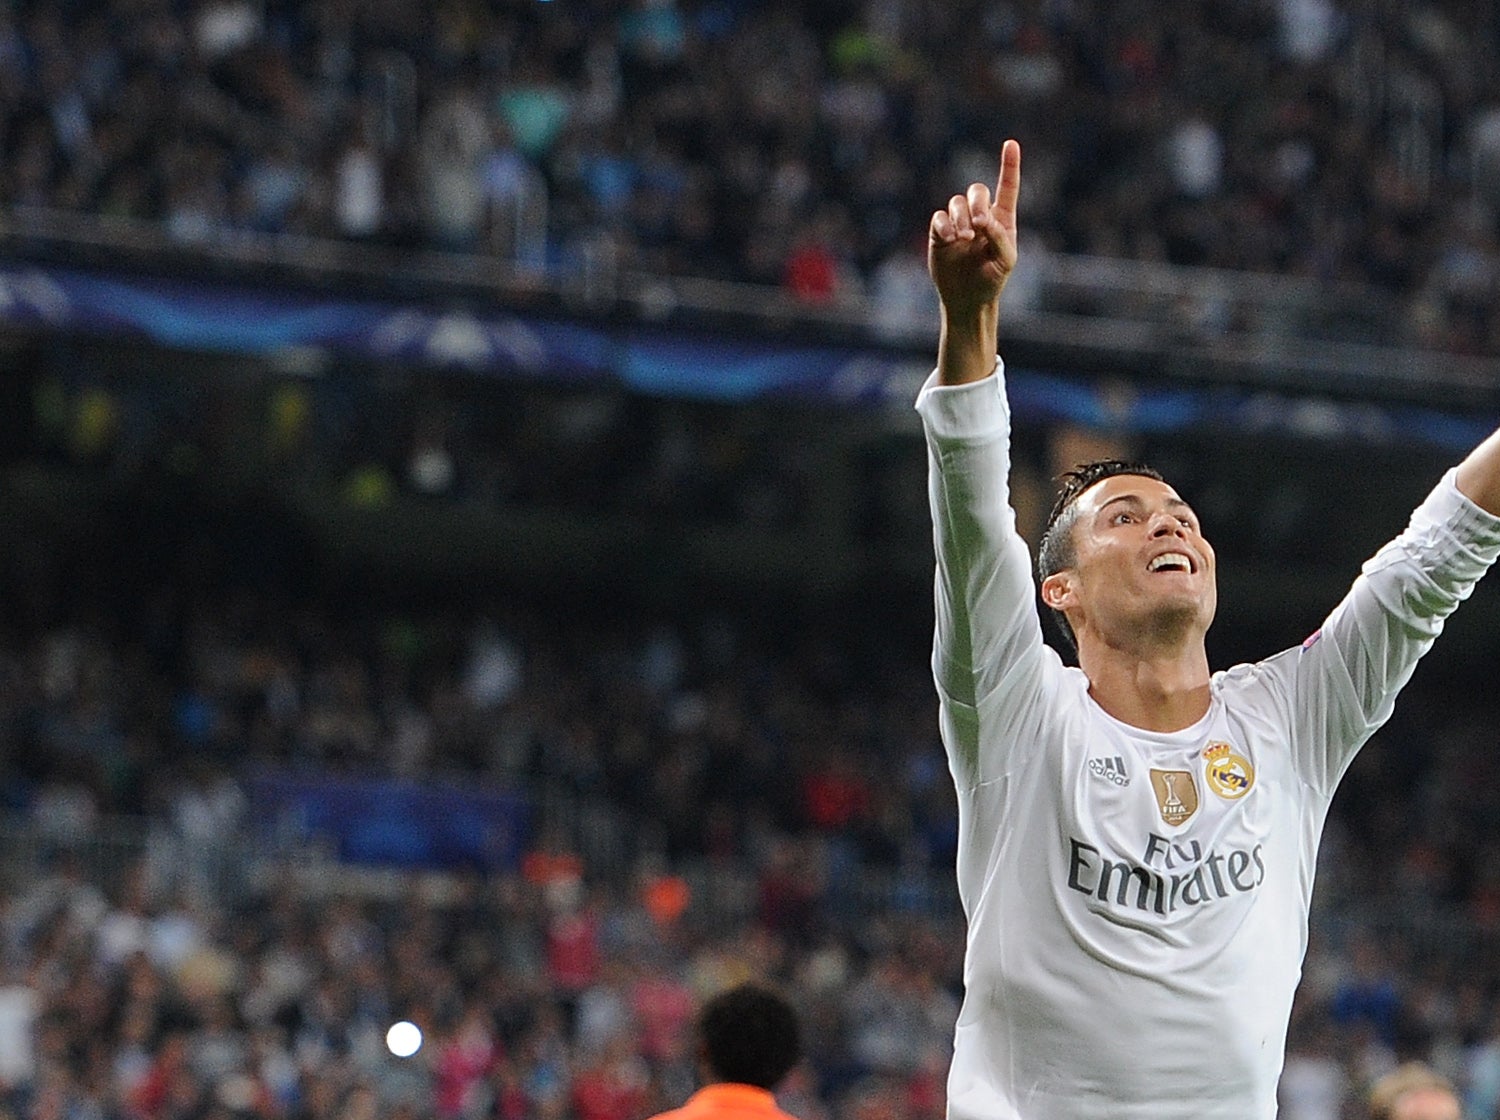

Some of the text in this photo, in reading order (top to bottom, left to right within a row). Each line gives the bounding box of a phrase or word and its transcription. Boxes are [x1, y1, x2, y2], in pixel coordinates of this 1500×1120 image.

[1088, 759, 1130, 787] adidas
[1163, 804, 1186, 813] FIFA
[1143, 832, 1201, 870] Fly
[1068, 837, 1265, 915] Emirates
